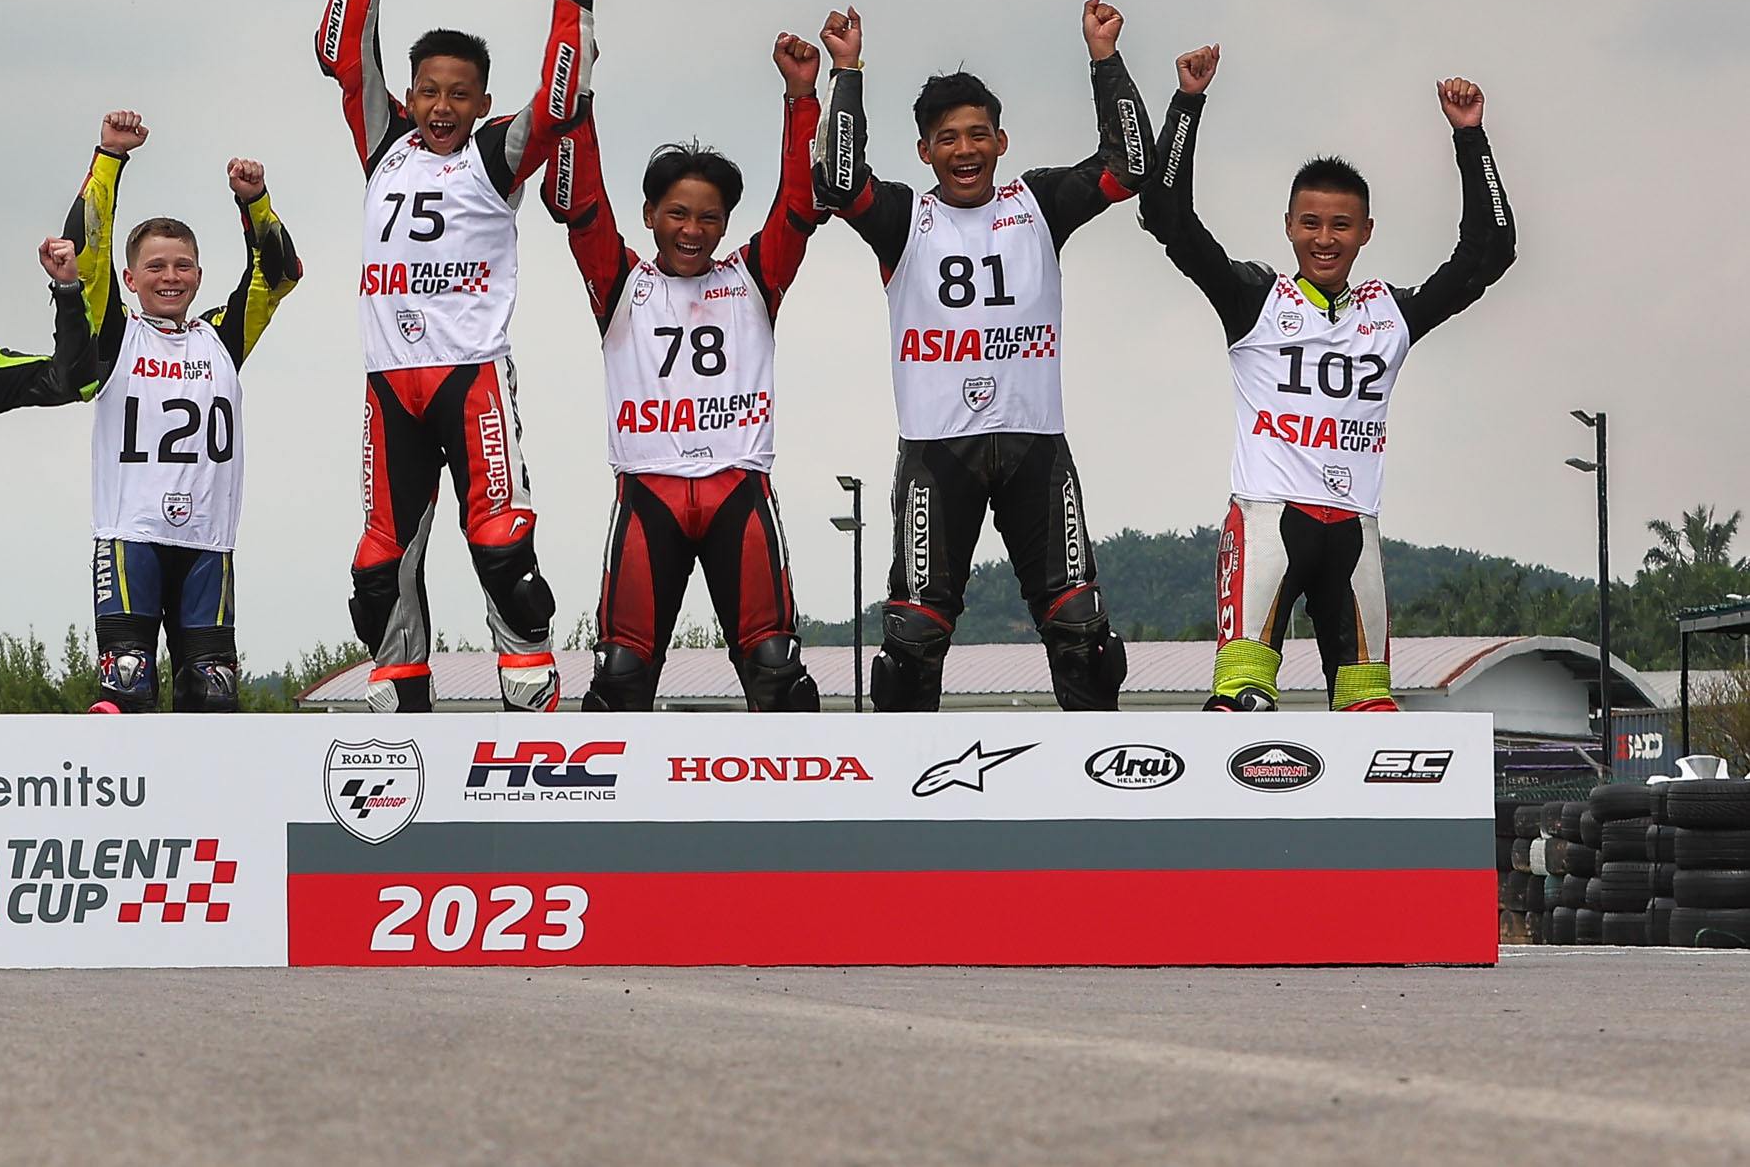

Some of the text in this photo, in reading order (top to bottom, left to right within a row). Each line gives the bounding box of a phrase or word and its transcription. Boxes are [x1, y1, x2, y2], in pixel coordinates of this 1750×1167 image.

[552, 44, 574, 118] KUSHITANI
[380, 191, 446, 243] 75
[411, 262, 479, 278] TALENT
[411, 279, 450, 295] CUP
[938, 254, 1016, 309] 81
[704, 286, 731, 301] ASIA
[654, 325, 727, 378] 78
[900, 325, 1046, 362] ASIA TALENT
[984, 343, 1020, 361] CUP
[132, 356, 183, 381] ASIA
[1277, 345, 1387, 402] 102
[119, 396, 233, 464] 120
[617, 392, 758, 434] ASIA TALENT
[698, 413, 736, 431] CUP
[1252, 410, 1338, 451] ASIA
[1340, 436, 1371, 453] CUP
[487, 460, 509, 500] Satu
[914, 487, 930, 593] HONDA
[1063, 483, 1080, 584] HONDA
[341, 752, 408, 767] ROAD TO
[465, 741, 628, 789] HRC
[667, 756, 874, 783] HONDA
[1091, 750, 1174, 778] Arai
[1243, 765, 1309, 778] KUSHITANI
[1367, 772, 1443, 780] PROJECT
[1371, 751, 1454, 773] SC
[463, 789, 617, 802] Honda RACING
[7, 838, 193, 879] TALENT
[7, 882, 109, 924] CUP
[369, 884, 591, 953] 2023
